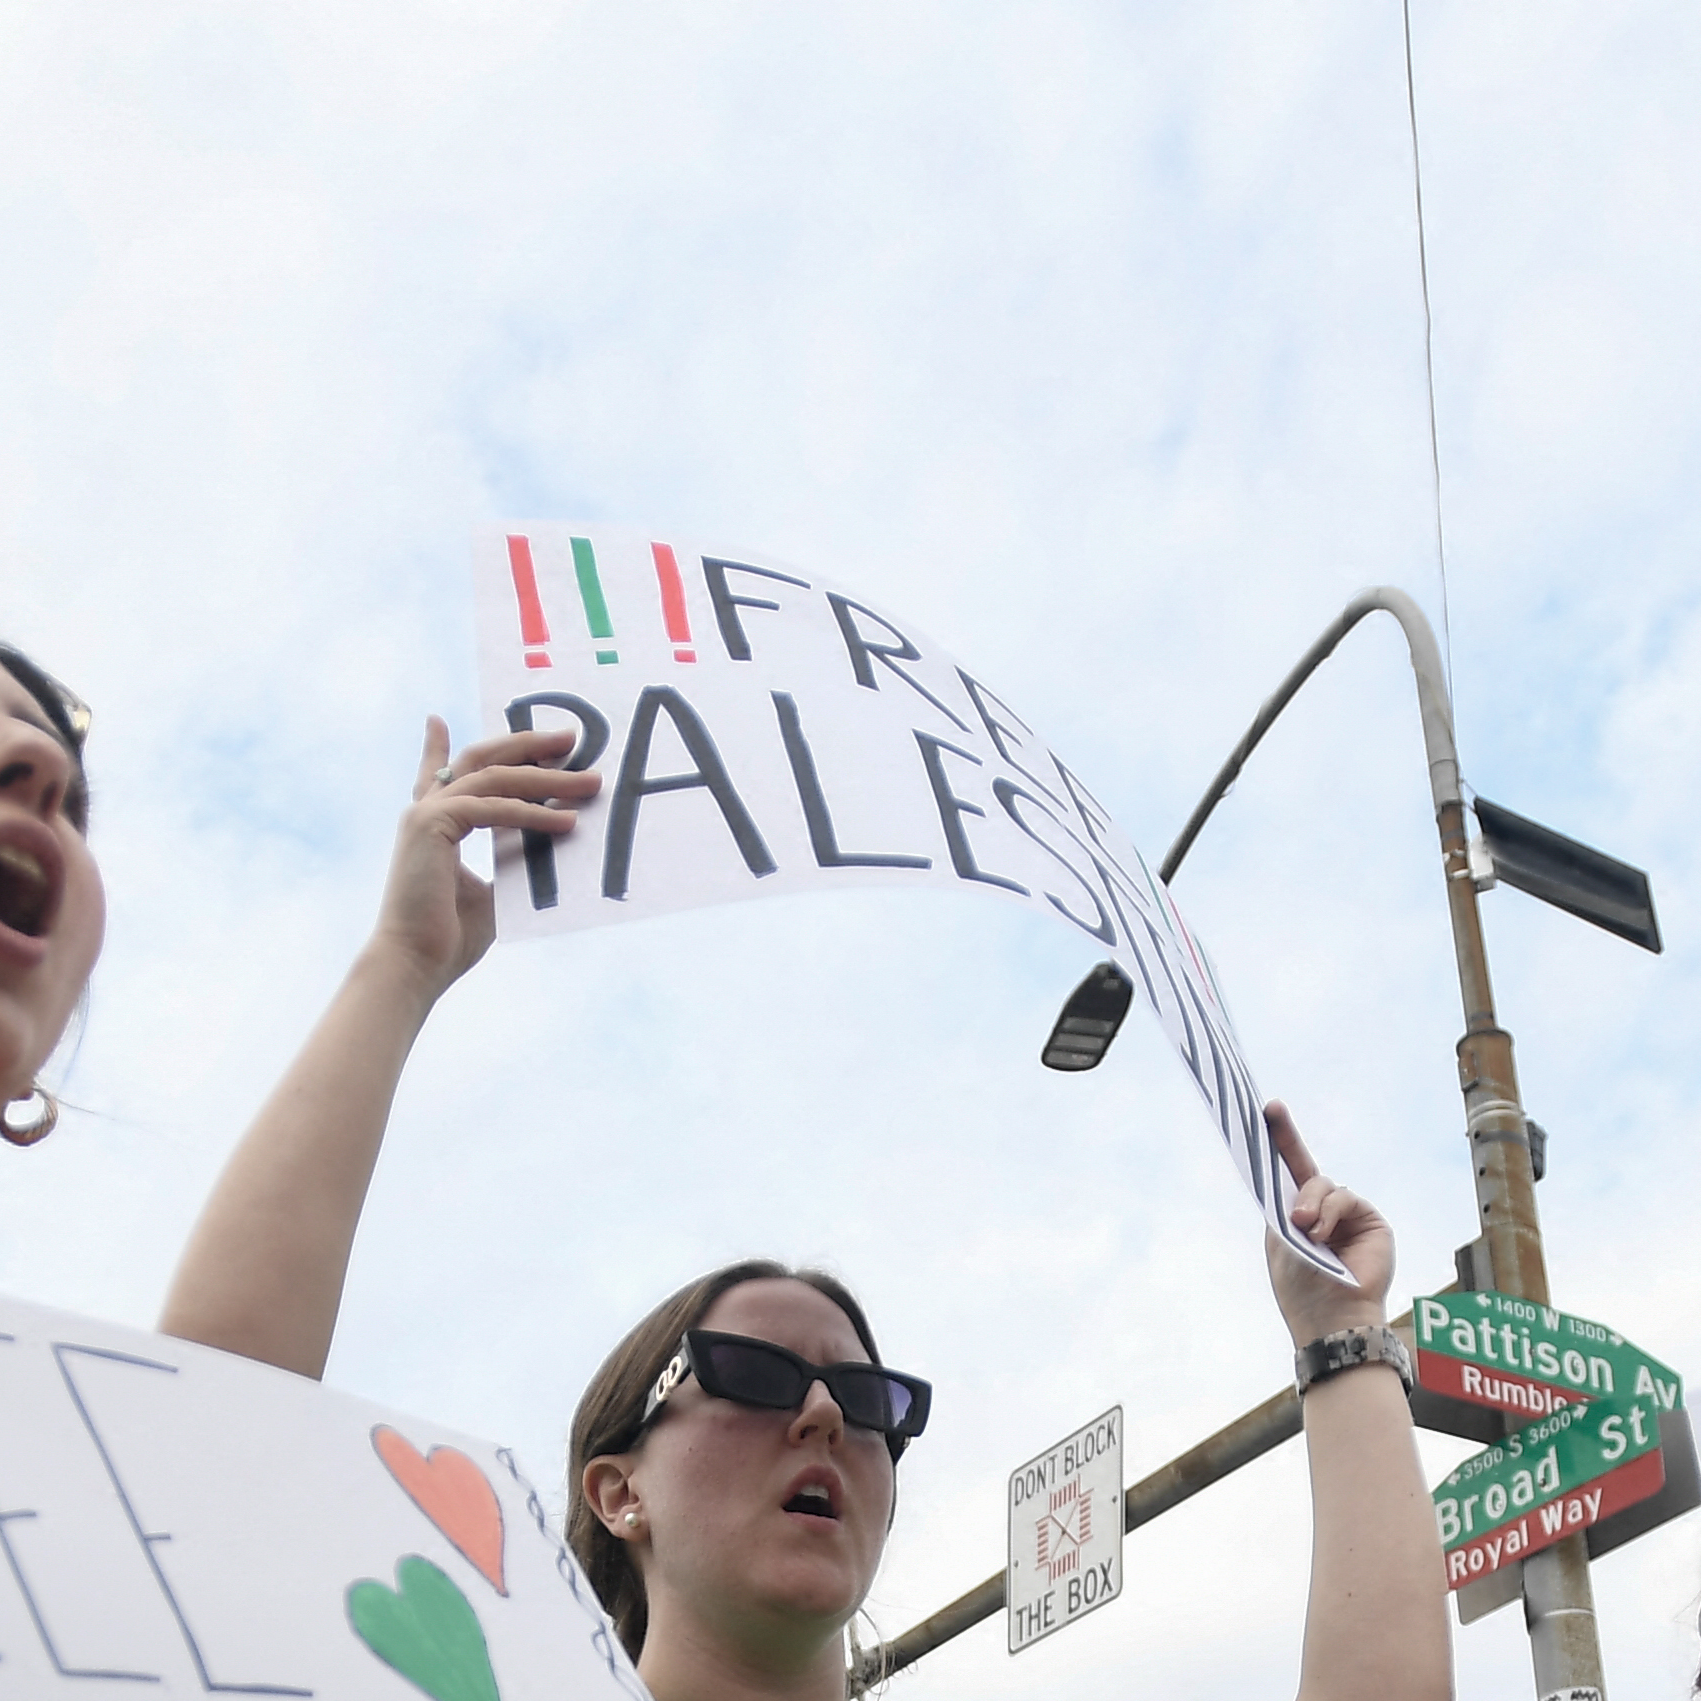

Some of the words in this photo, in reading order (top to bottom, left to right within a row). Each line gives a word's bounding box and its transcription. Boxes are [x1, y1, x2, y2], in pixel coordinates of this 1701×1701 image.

[1420, 1298, 1615, 1393] Pattison
[1635, 1365, 1678, 1411] Av
[1497, 1297, 1537, 1321] 1400
[1541, 1306, 1561, 1332] W
[1569, 1318, 1607, 1341] 1300
[1064, 1416, 1117, 1477] BLOCK
[1434, 1445, 1562, 1545] Broad
[1600, 1404, 1649, 1461] St
[1463, 1449, 1503, 1480] 3500
[1509, 1434, 1523, 1458] S
[1529, 1411, 1572, 1445] 3600
[1450, 1518, 1529, 1582] Royal
[1540, 1487, 1603, 1536] Way
[1015, 1589, 1057, 1642] THE
[1067, 1556, 1114, 1616] BOX
